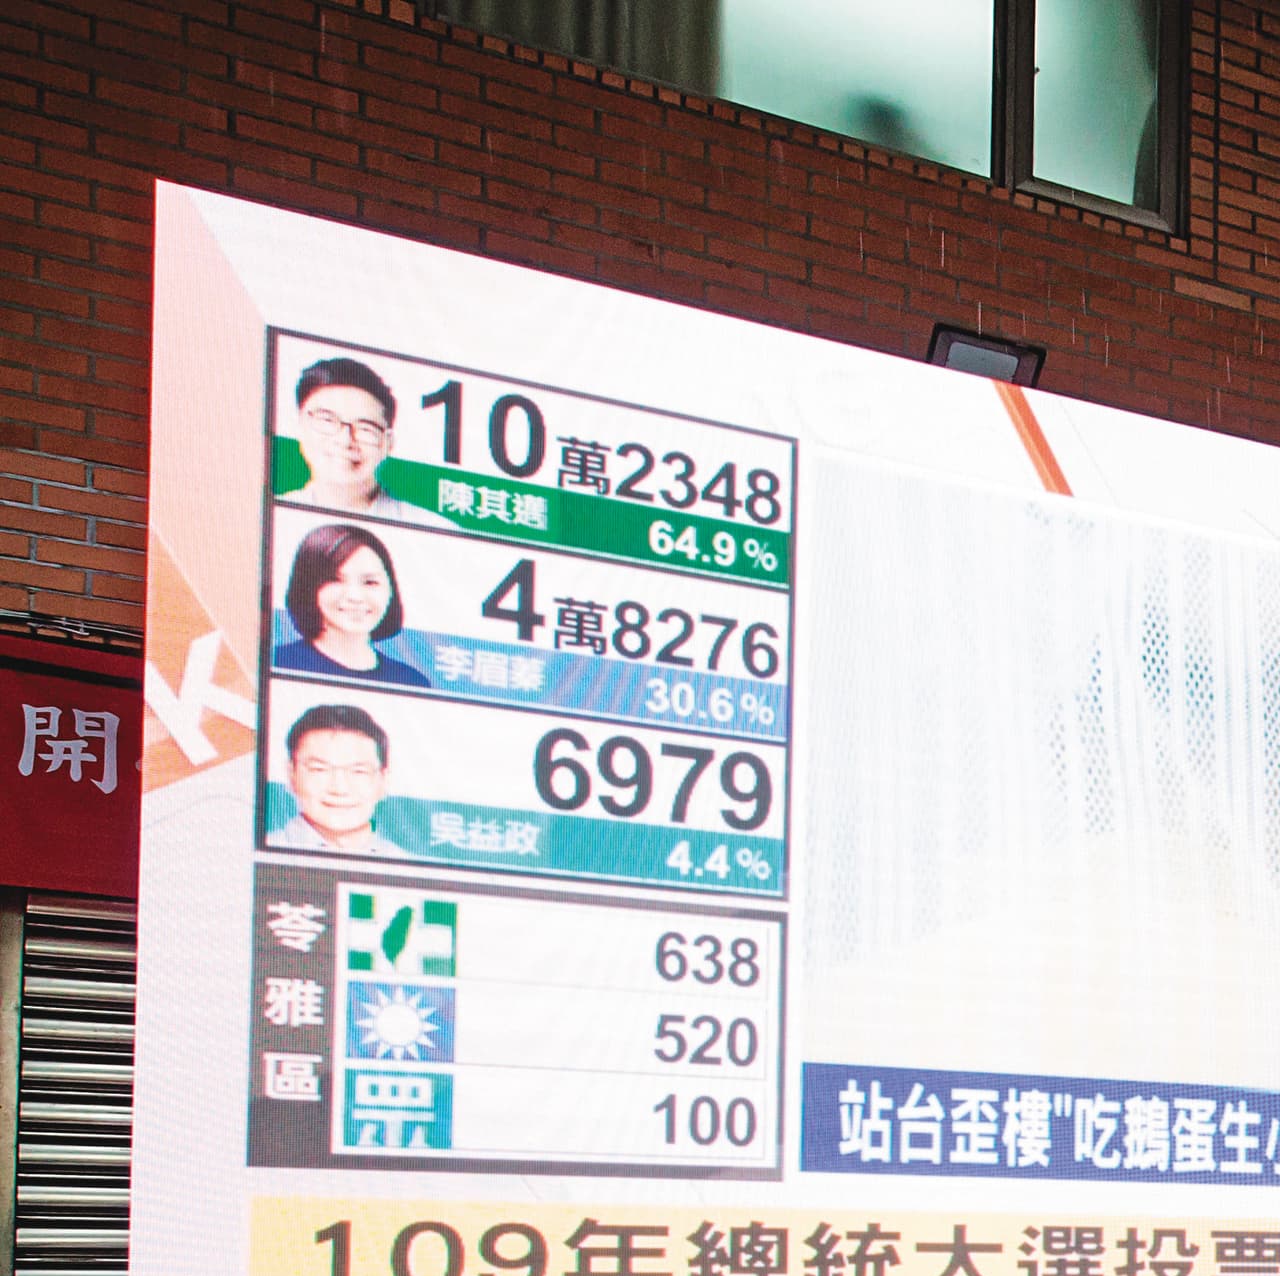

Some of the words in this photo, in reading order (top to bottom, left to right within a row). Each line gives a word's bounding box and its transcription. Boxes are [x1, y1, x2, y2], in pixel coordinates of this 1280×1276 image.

[421, 380, 782, 526] 10萬2348
[438, 479, 548, 531] 陳其邁
[649, 519, 778, 572] 64.9%
[481, 559, 780, 679] 4萬8276
[645, 678, 775, 727] 30.6%
[18, 703, 120, 795] 開
[532, 727, 773, 832] 6979
[666, 840, 773, 882] 4.4%
[654, 930, 761, 987] 638
[262, 900, 327, 1102] 苓雅區
[653, 1013, 759, 1067] 520
[652, 1093, 758, 1147] 100
